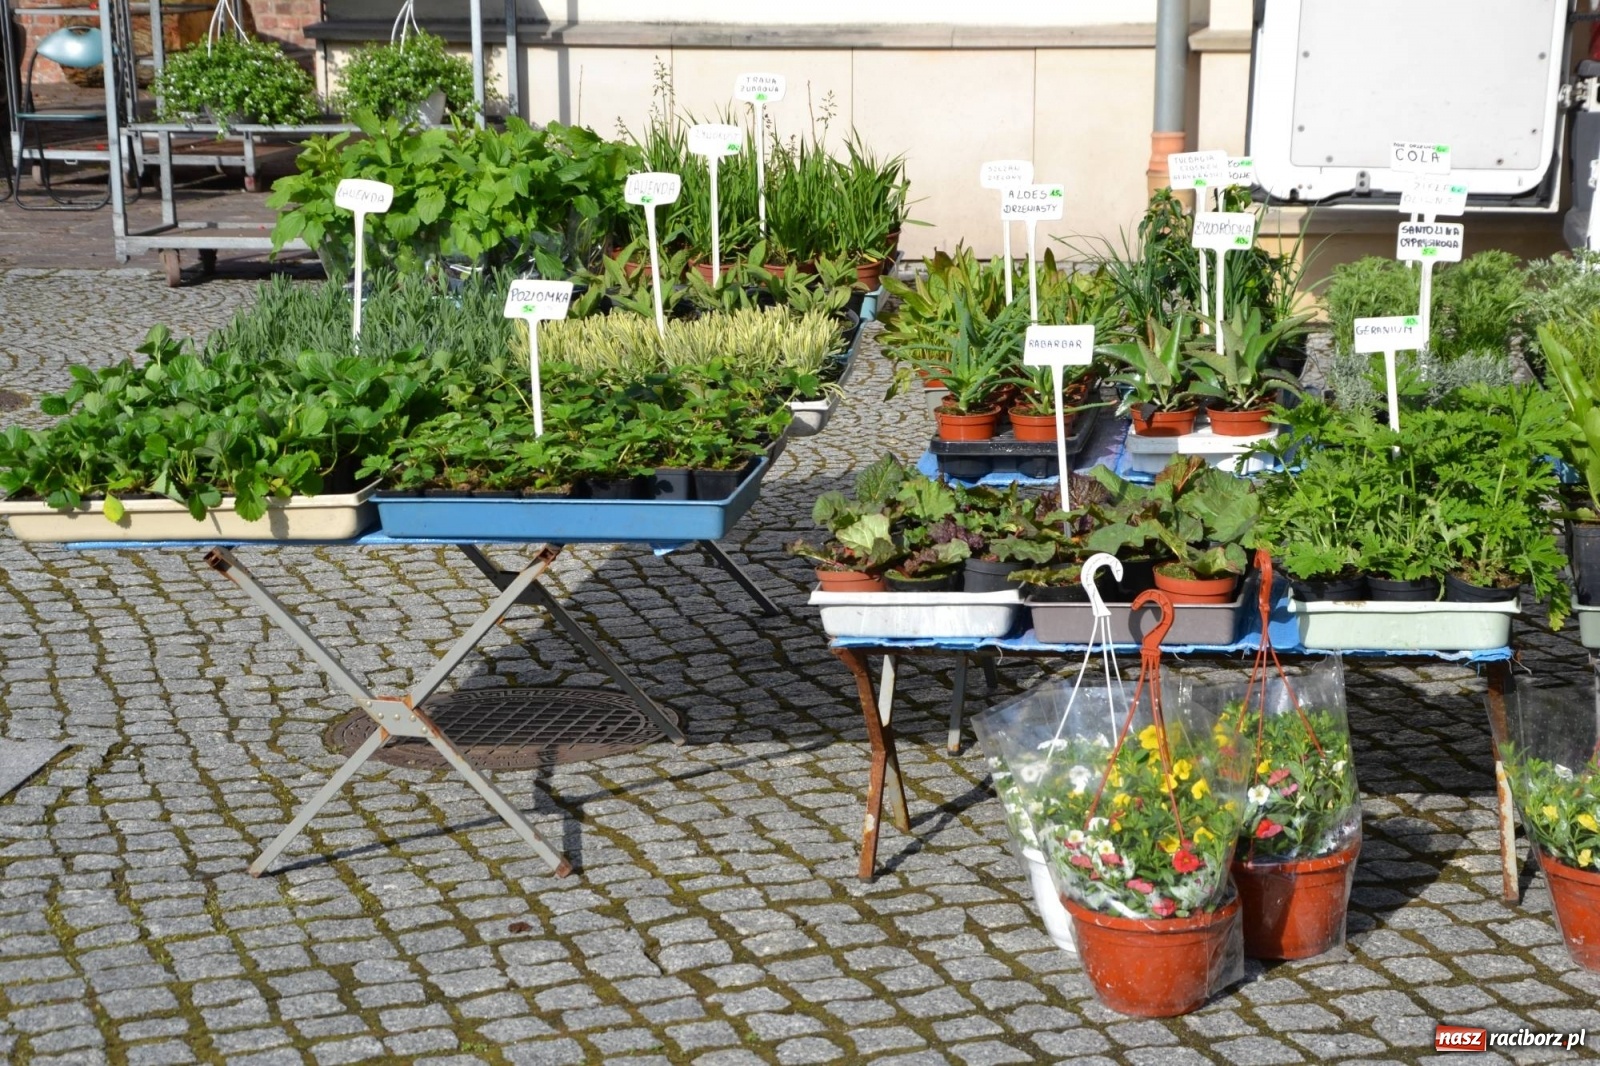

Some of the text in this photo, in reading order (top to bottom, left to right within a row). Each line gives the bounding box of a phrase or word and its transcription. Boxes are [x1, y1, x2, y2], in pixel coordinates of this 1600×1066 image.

[1395, 147, 1441, 164] COLA
[1008, 189, 1048, 200] ALOES
[1401, 225, 1460, 237] SANTOLINA
[510, 287, 570, 305] POZIOMKA
[1355, 325, 1414, 337] GERANIUM
[1028, 339, 1083, 350] RABARBAR
